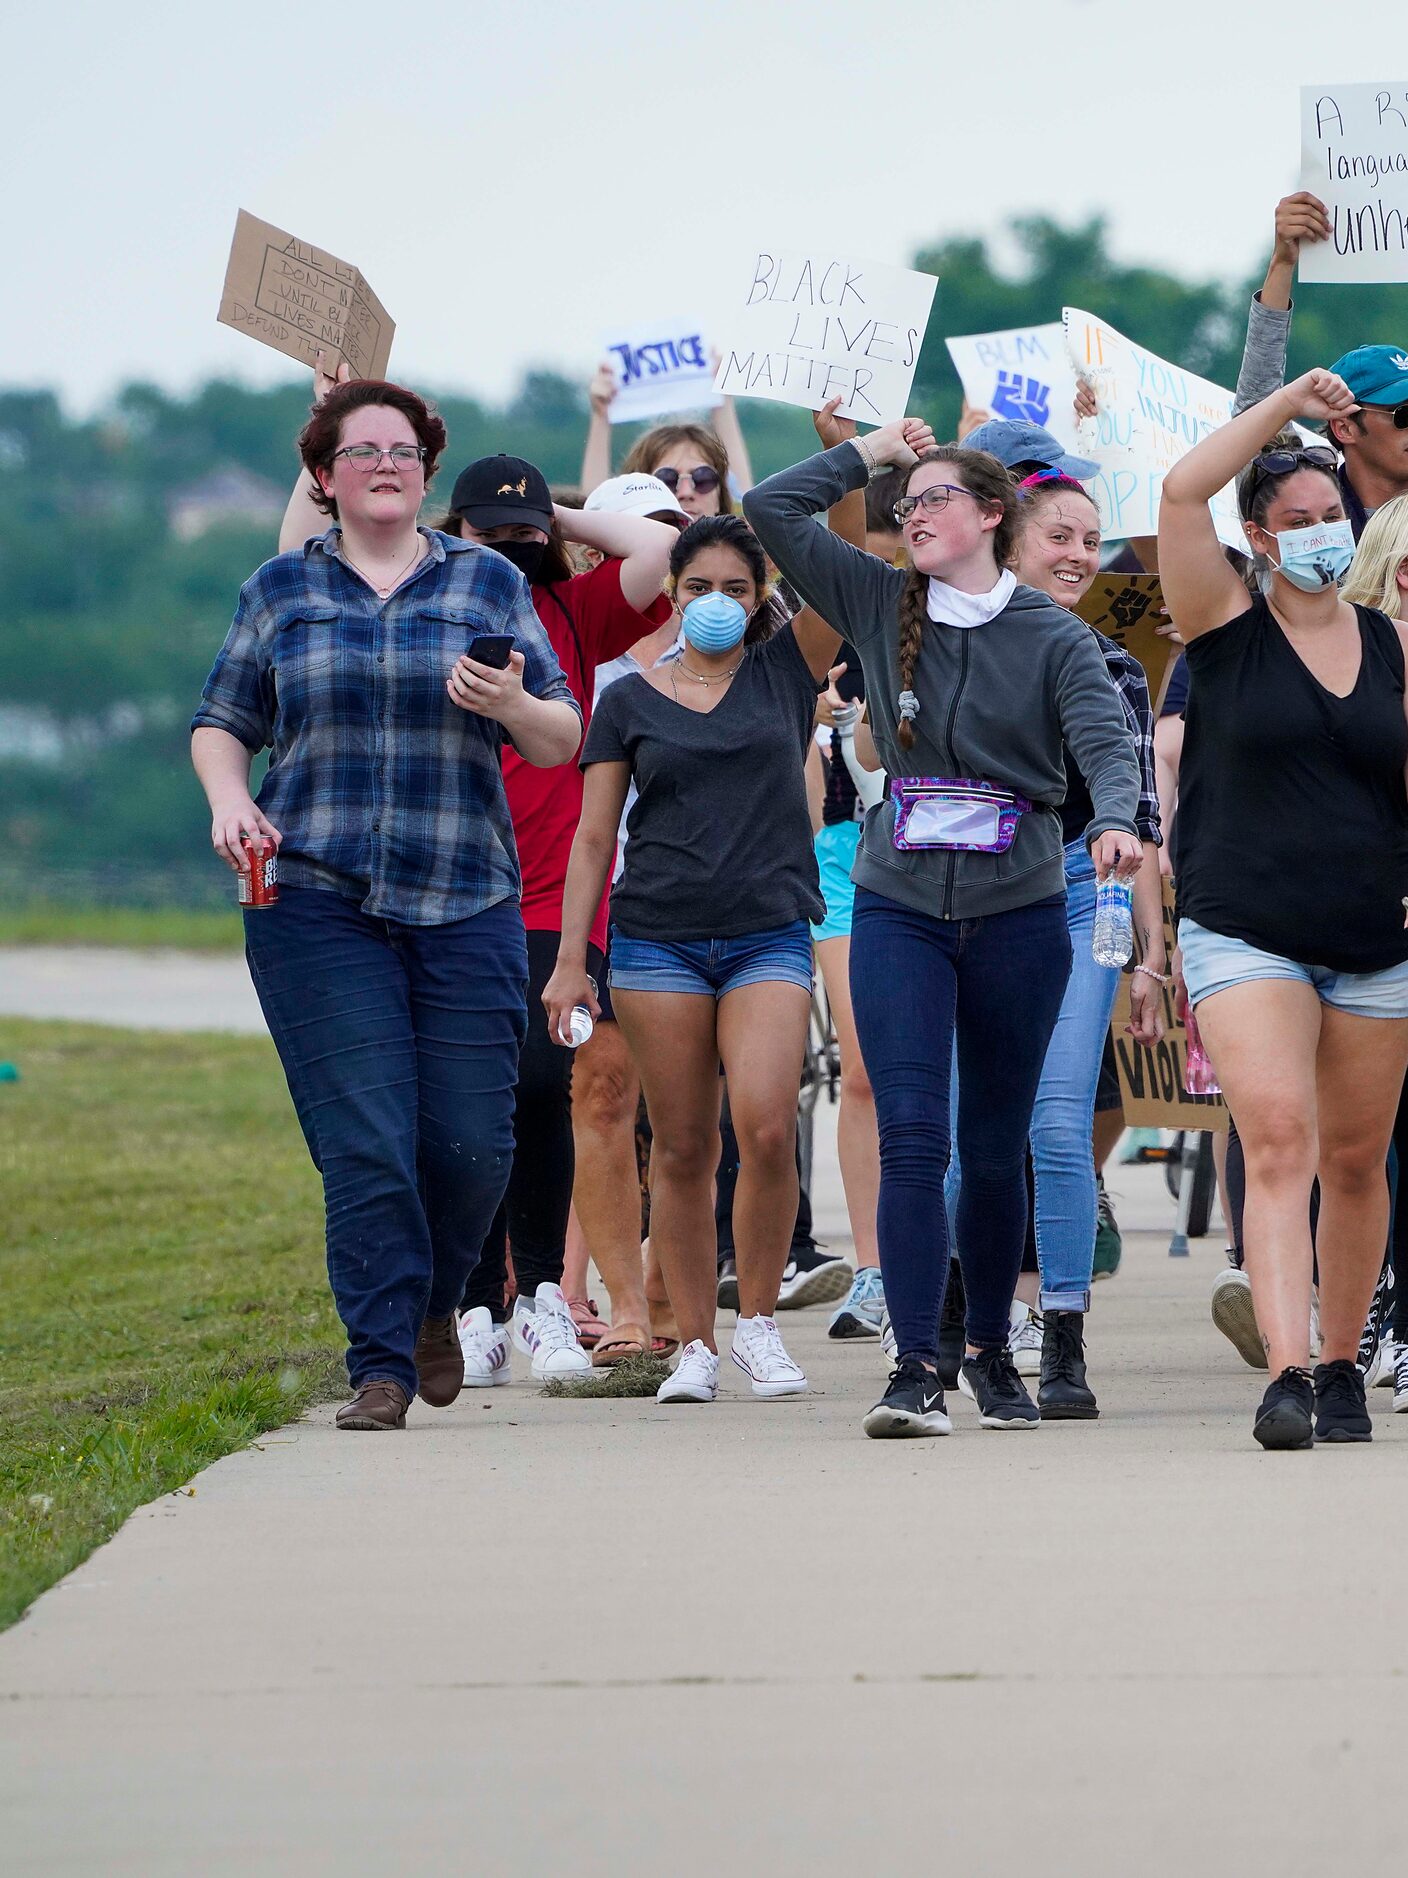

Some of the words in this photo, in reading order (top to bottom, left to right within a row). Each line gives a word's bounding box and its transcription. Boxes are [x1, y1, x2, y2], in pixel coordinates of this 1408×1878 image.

[1315, 95, 1344, 139] A
[282, 237, 323, 267] ALL
[280, 259, 335, 293] DONT
[745, 254, 866, 306] BLACK
[273, 300, 315, 329] LIVES
[280, 282, 323, 313] UNTIL
[231, 302, 289, 340] DEFUND
[788, 312, 919, 368] LIVES
[607, 334, 707, 385] JUSTICE
[973, 334, 1051, 369] BLM
[721, 350, 882, 417] MATTER
[1131, 349, 1188, 406] YOU
